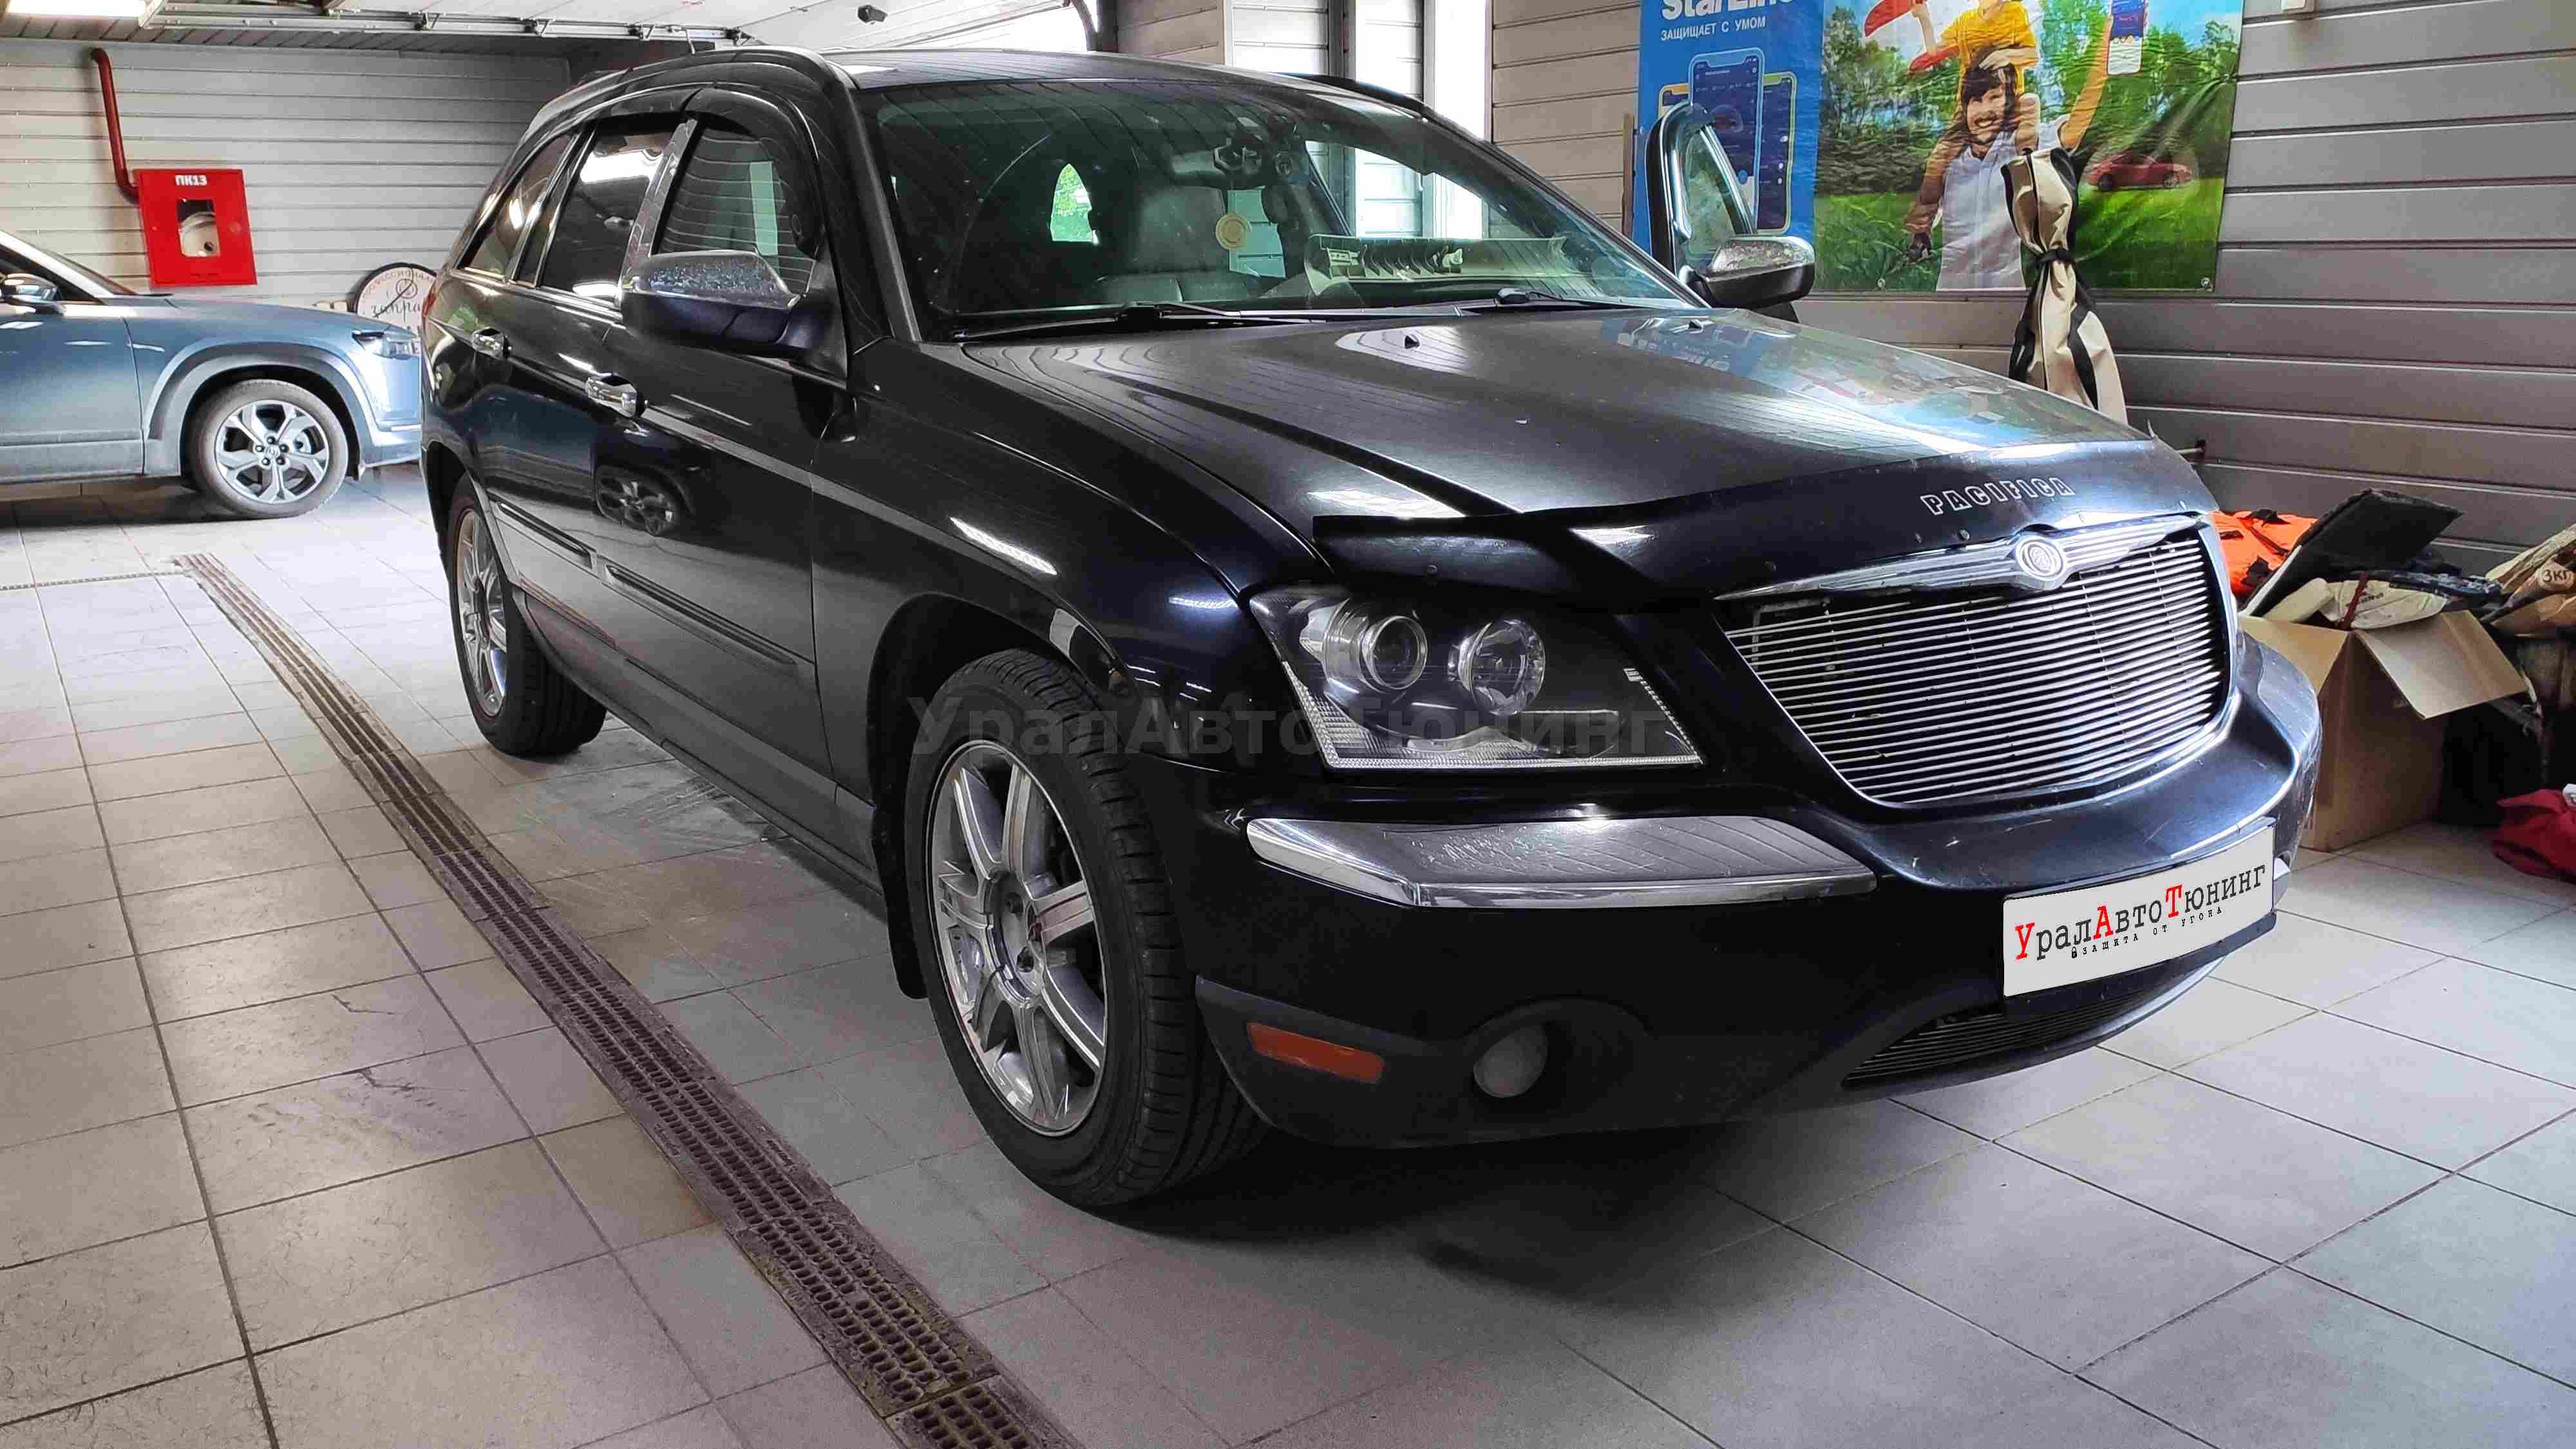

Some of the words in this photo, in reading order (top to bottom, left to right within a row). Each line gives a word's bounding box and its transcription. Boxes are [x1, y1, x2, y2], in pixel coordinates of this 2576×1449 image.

[1661, 0, 1795, 20] Star
[1661, 23, 1716, 41] ЗАЩИЩАЕТ
[1721, 21, 1730, 32] С
[1735, 15, 1766, 31] УМОМ
[175, 175, 207, 186] ПК13
[1920, 477, 2076, 516] PACIFICA
